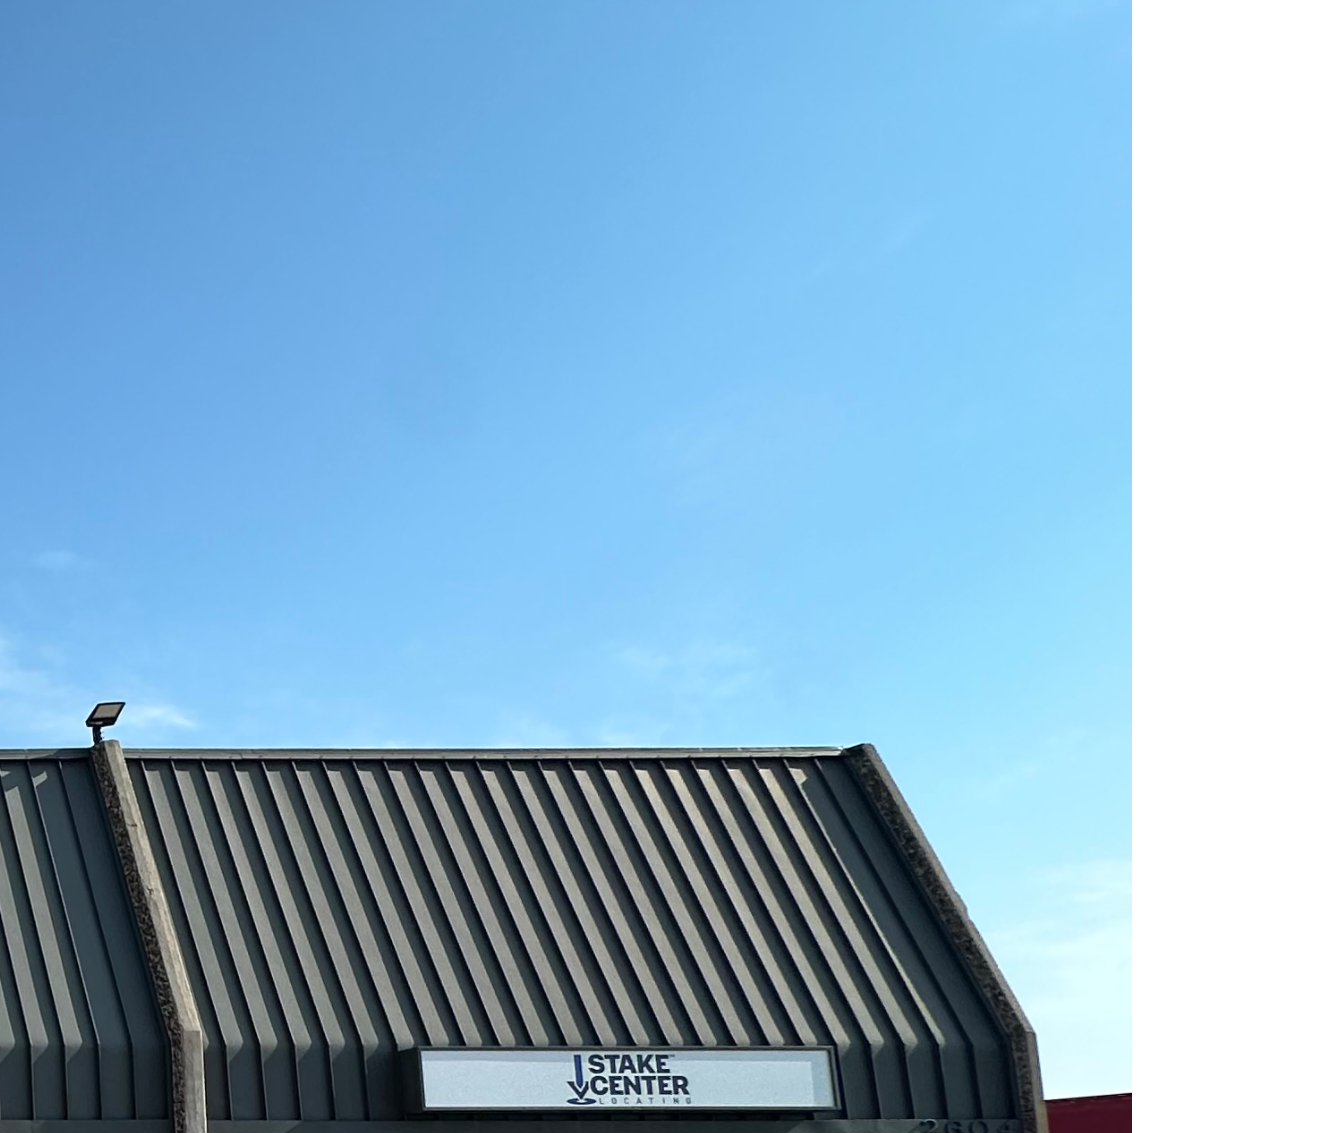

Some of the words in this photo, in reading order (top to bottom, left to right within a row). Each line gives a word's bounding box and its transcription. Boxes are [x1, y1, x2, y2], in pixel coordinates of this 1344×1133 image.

[587, 1054, 671, 1074] STAKE
[590, 1075, 690, 1096] CENTER
[598, 1097, 692, 1105] LOCATING
